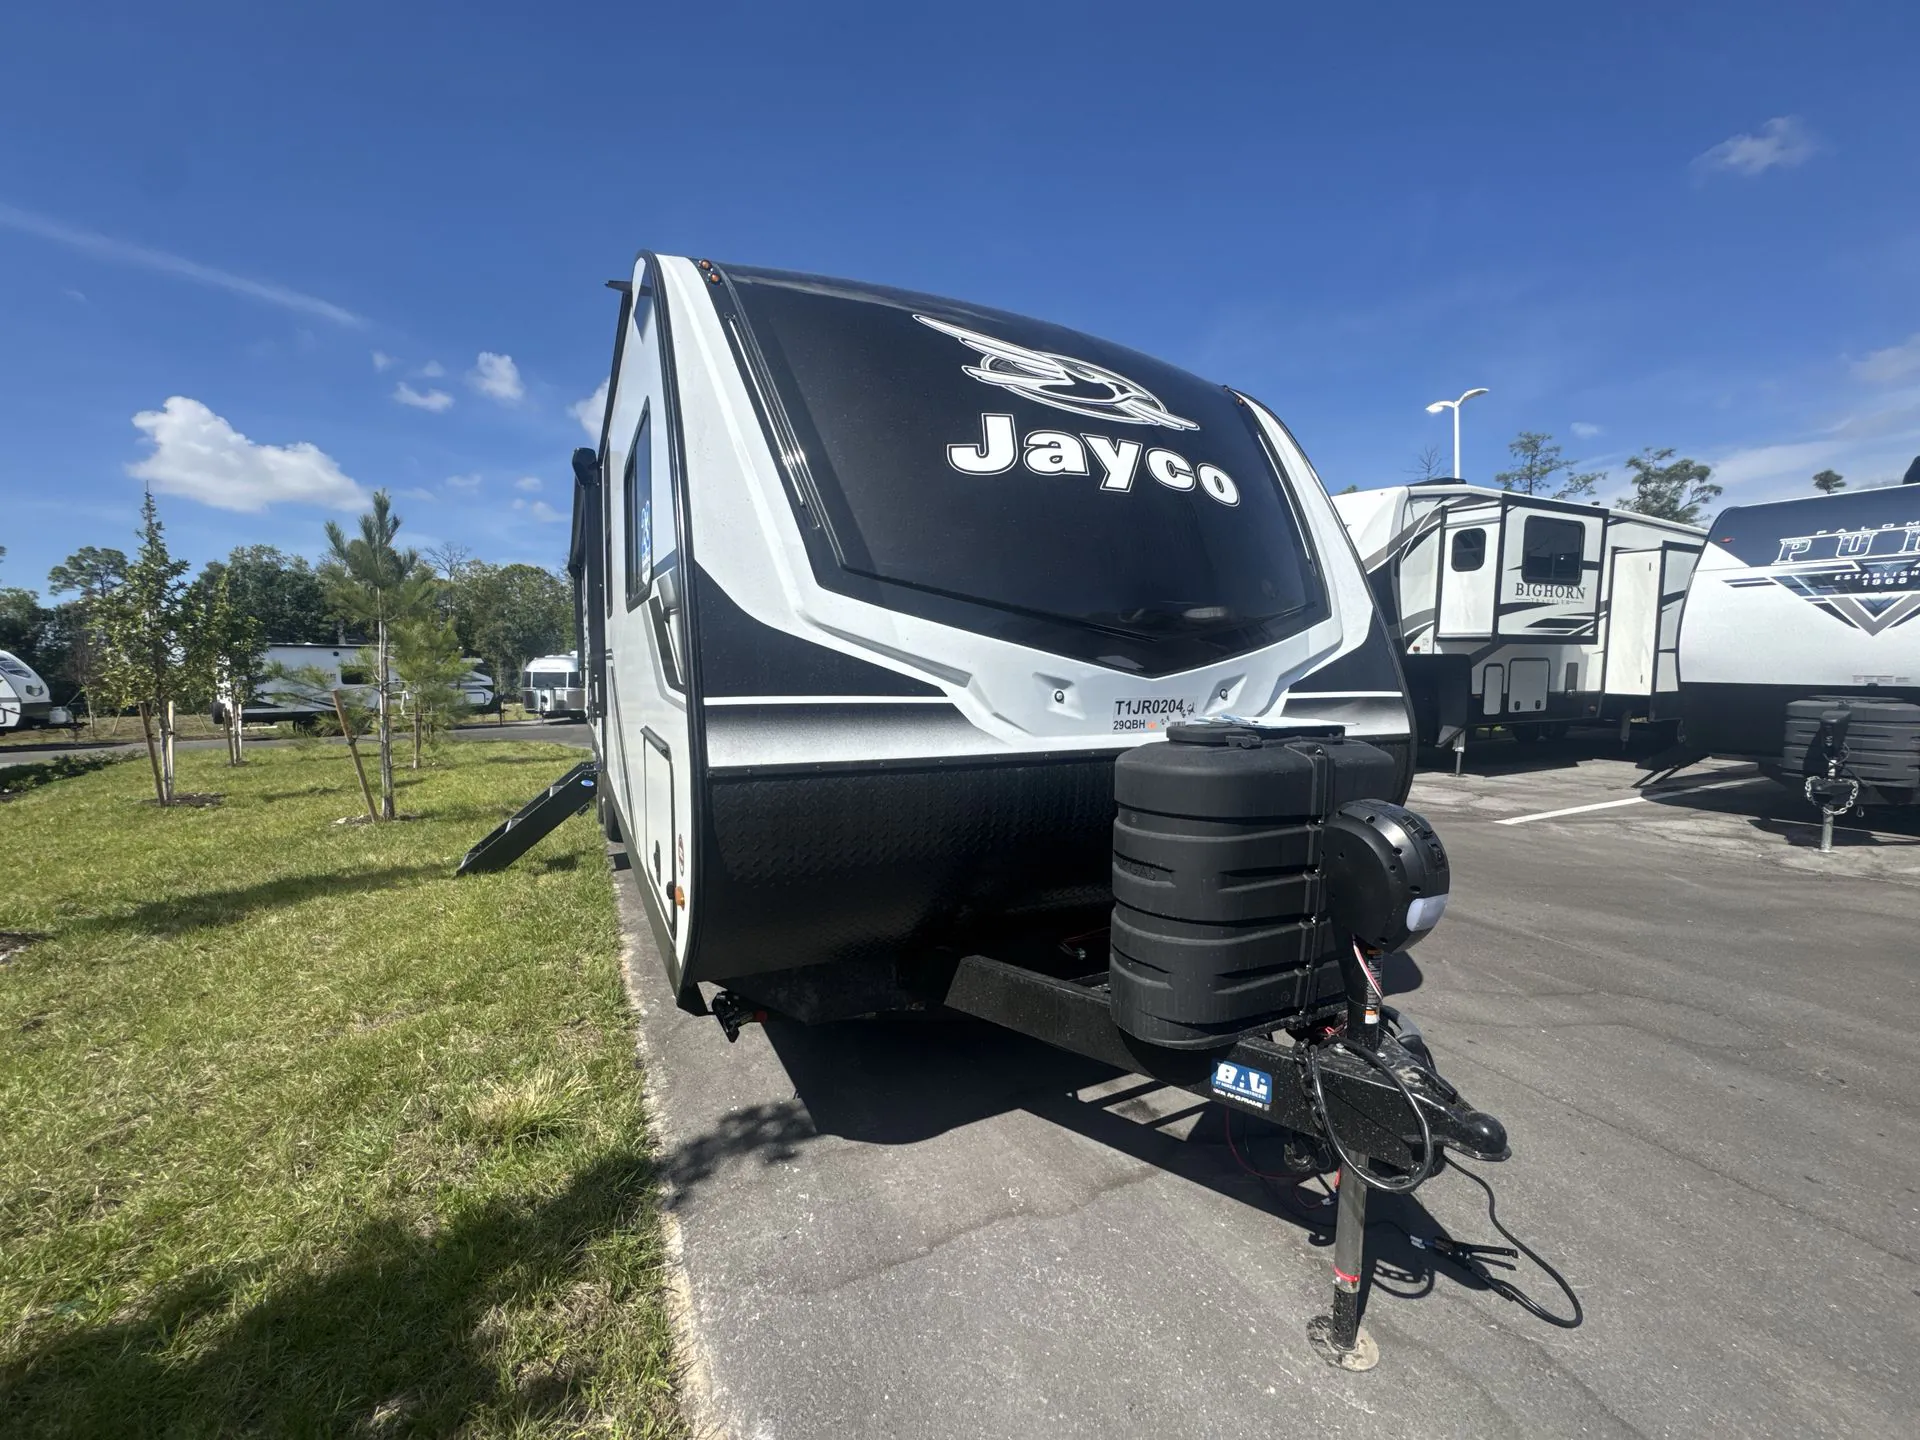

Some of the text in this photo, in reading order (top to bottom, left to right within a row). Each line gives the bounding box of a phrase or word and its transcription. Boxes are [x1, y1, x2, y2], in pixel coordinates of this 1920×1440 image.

[947, 412, 1240, 507] Jayco
[1515, 582, 1586, 600] BIGHORN
[1862, 577, 1908, 587] 1968
[1115, 698, 1184, 716] T1JR0204
[1113, 719, 1146, 731] 29QBH
